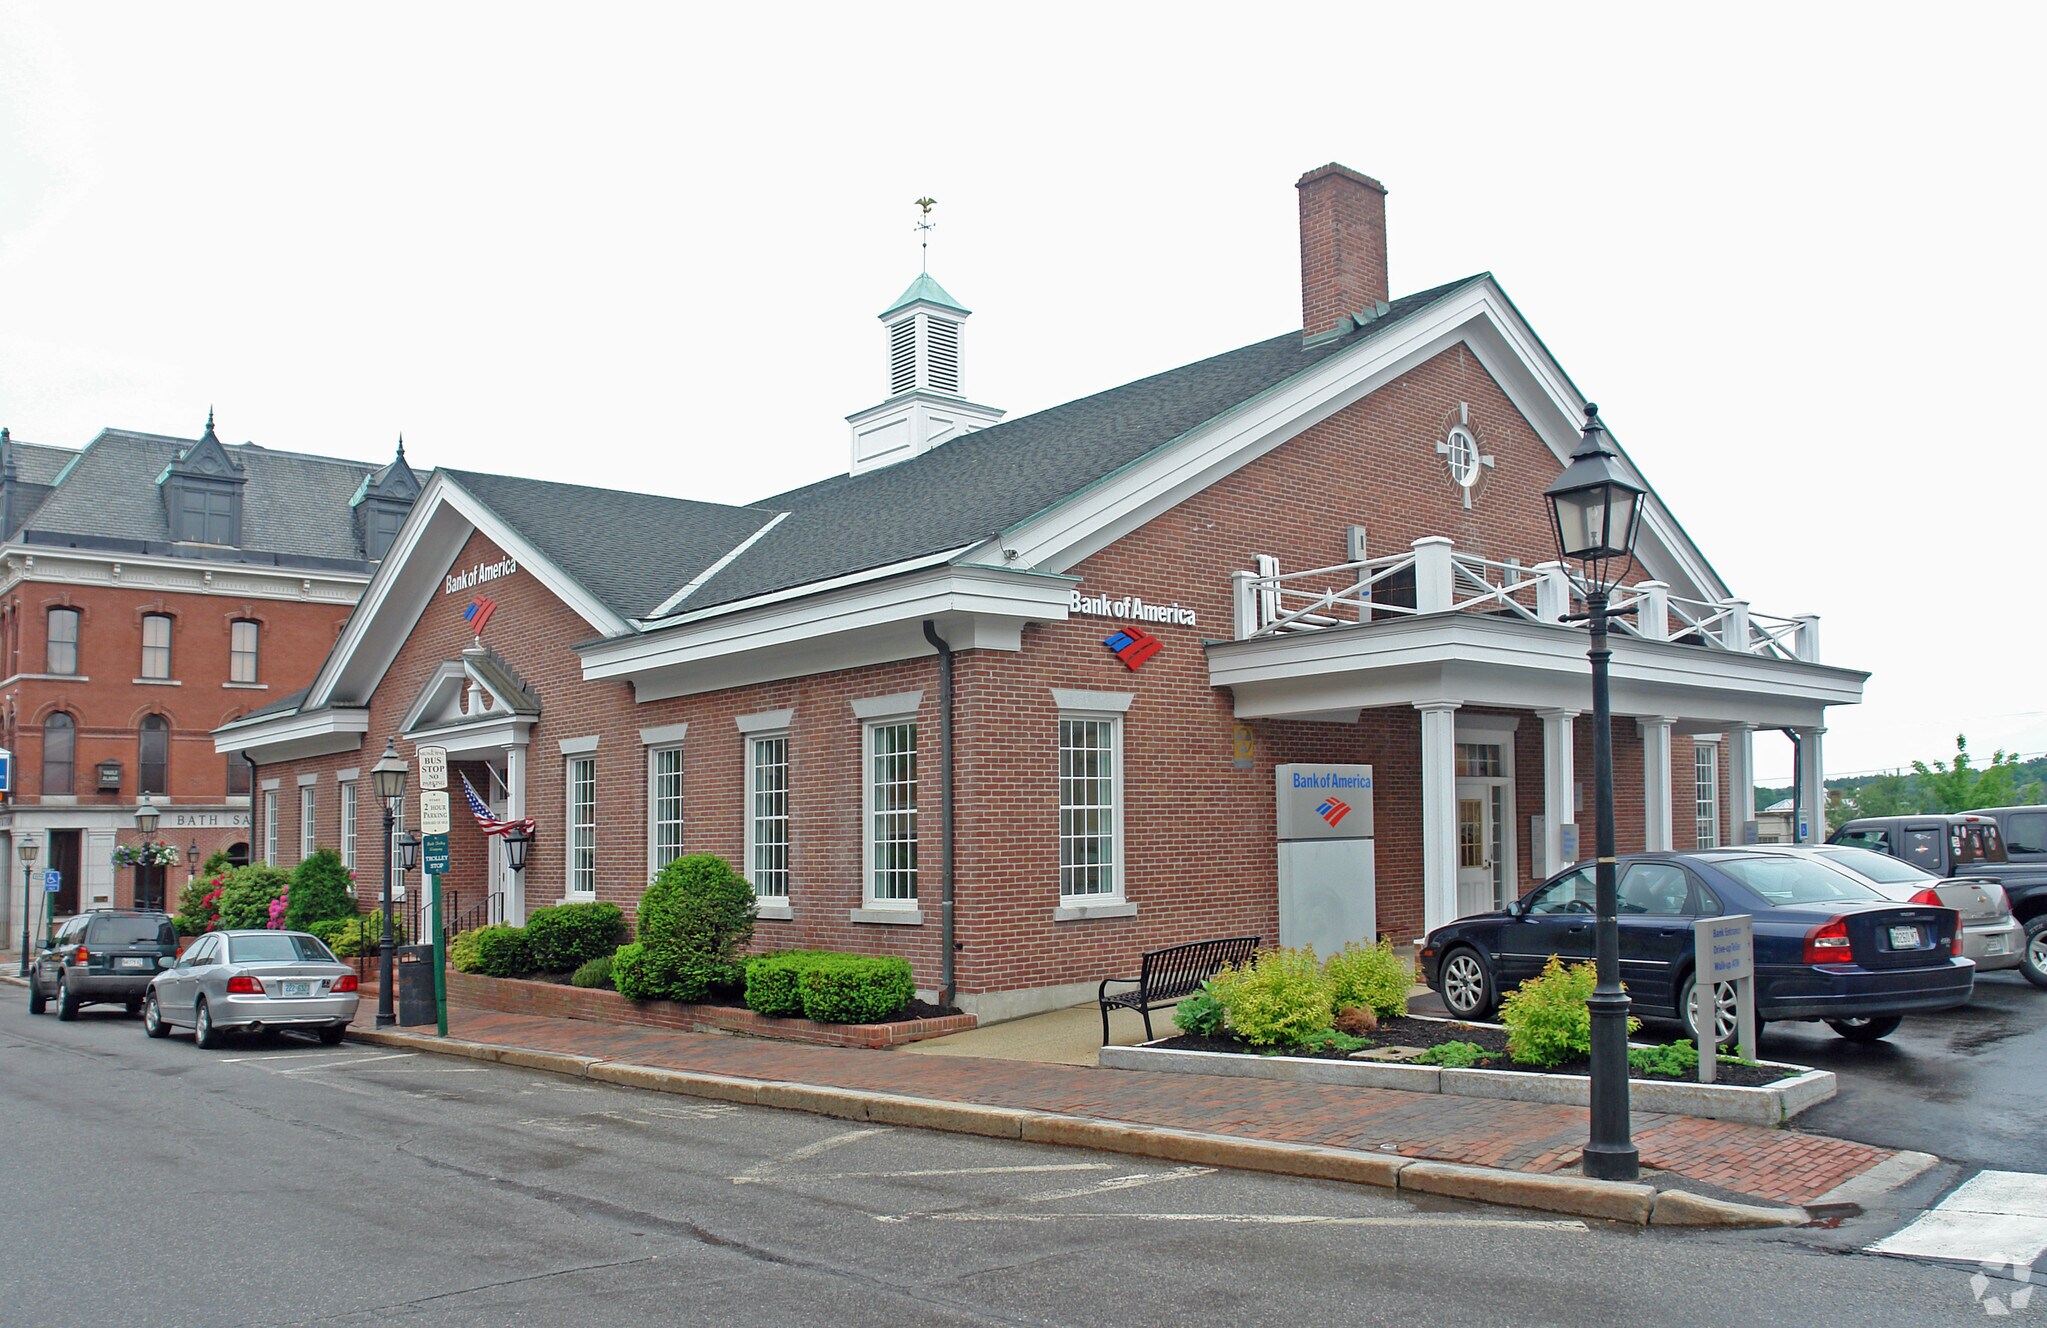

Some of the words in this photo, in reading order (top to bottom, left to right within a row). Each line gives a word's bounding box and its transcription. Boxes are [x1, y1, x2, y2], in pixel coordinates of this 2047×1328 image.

[445, 570, 468, 595] Bank
[468, 565, 478, 587] of
[478, 555, 517, 584] America
[1069, 589, 1112, 617] Bank
[1112, 596, 1131, 619] of
[1131, 597, 1196, 626] America
[424, 757, 442, 765] BUS
[421, 765, 445, 773] STOP
[1293, 772, 1319, 788] Bank
[1320, 772, 1330, 788] of
[1331, 772, 1371, 788] America
[424, 803, 429, 811] 2
[177, 815, 218, 826] BATH
